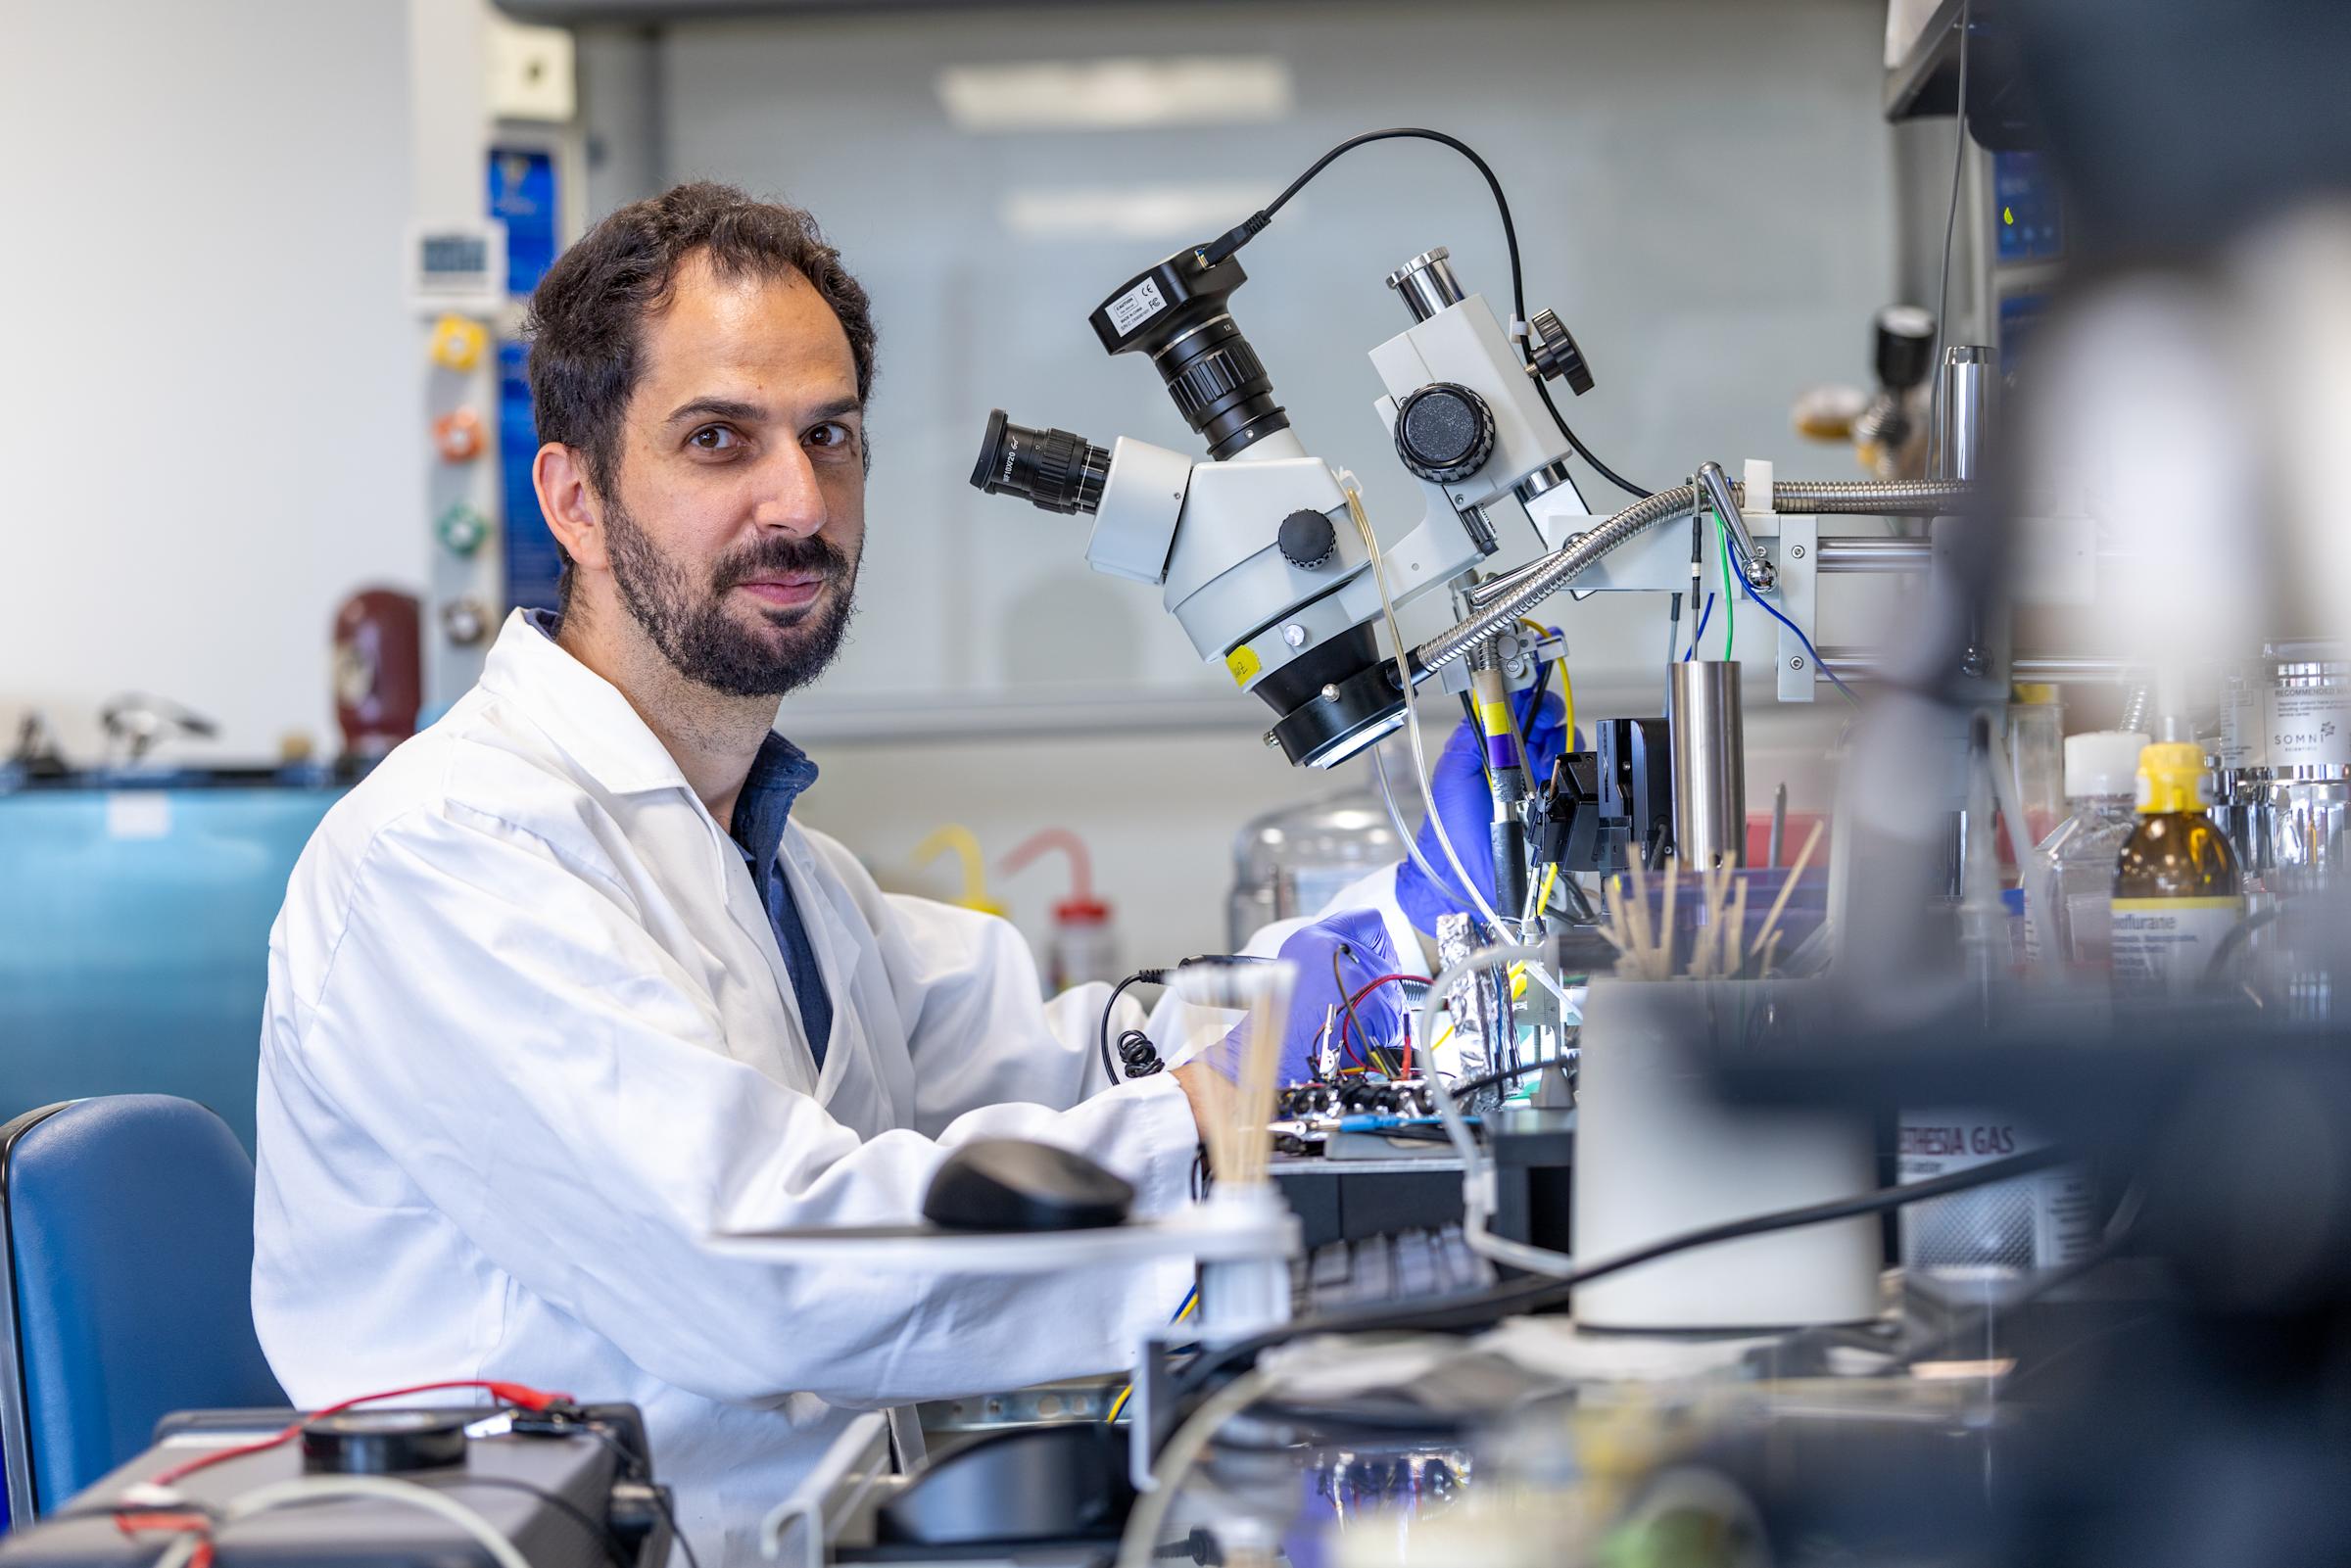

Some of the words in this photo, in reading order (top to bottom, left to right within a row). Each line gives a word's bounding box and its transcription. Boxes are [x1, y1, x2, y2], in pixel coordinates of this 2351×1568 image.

[1116, 297, 1133, 311] CAUTION
[2275, 688, 2334, 697] RECOMMENDED
[2274, 735, 2324, 745] SOMNI
[1971, 1126, 2015, 1155] GAS
